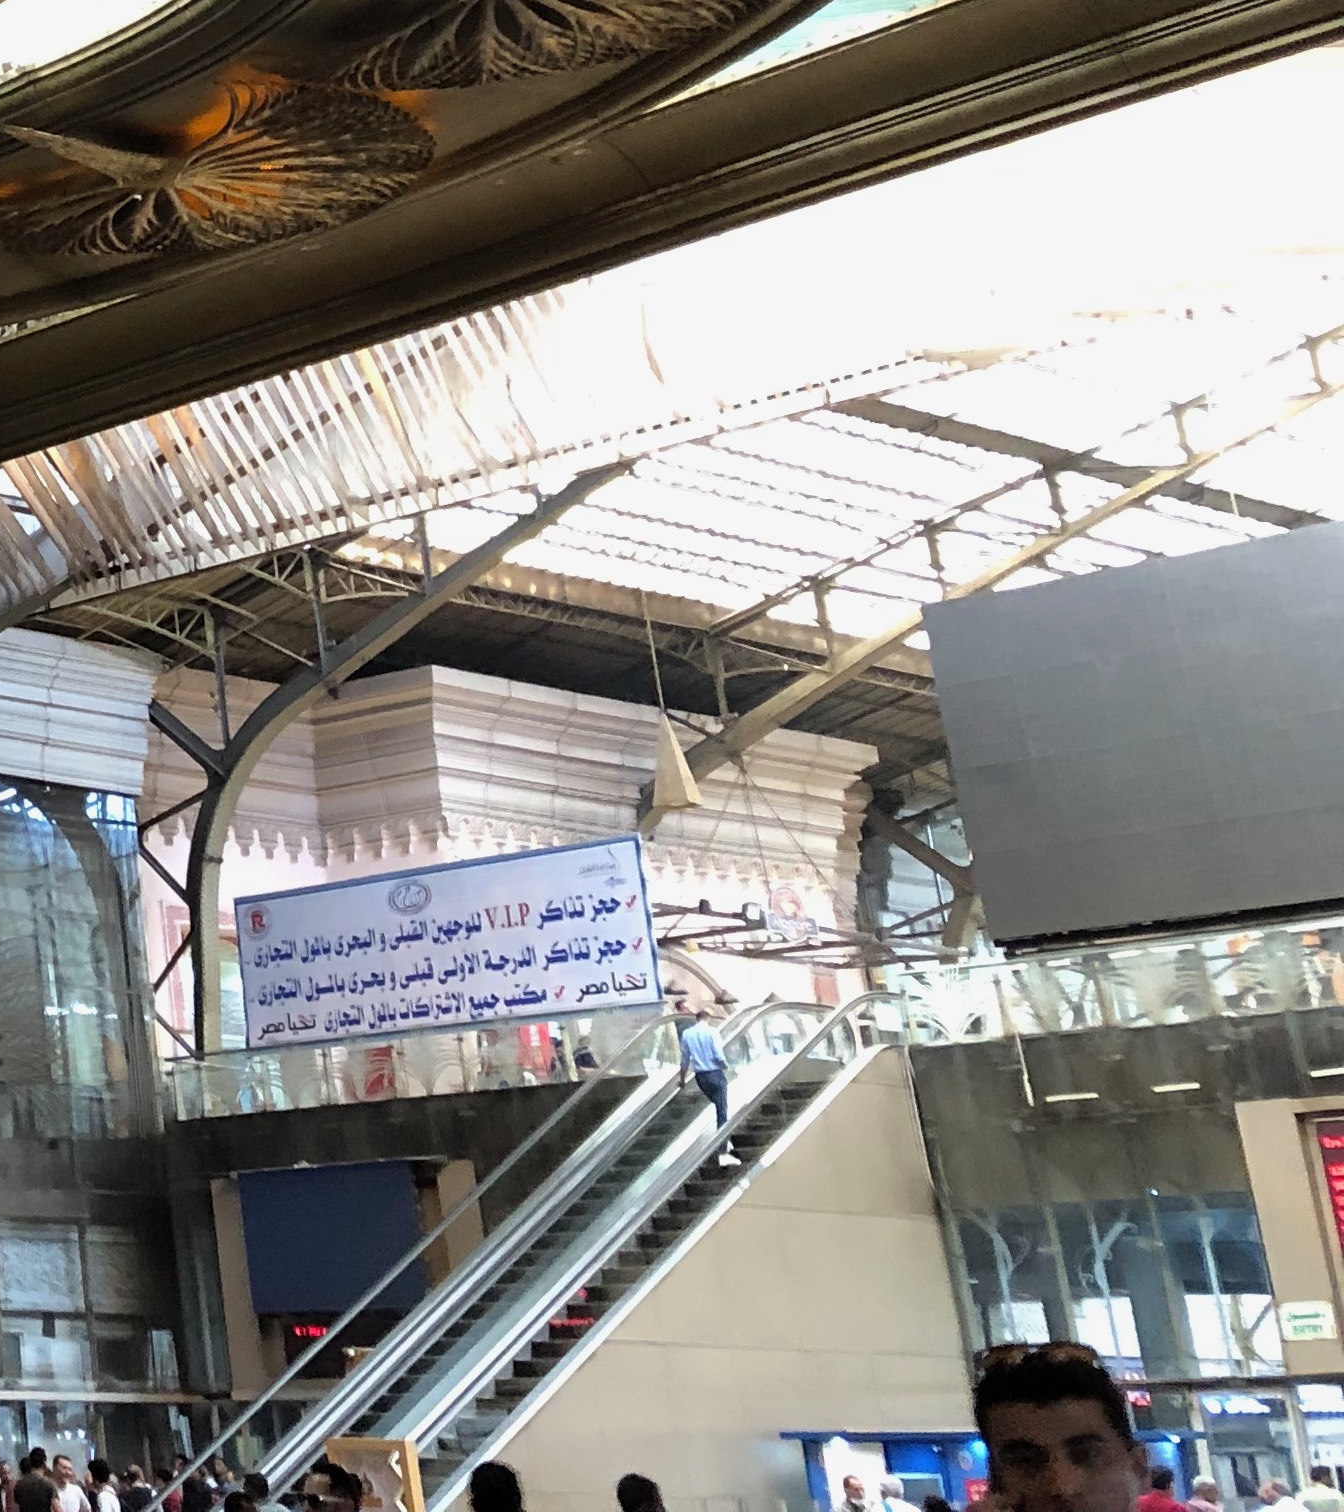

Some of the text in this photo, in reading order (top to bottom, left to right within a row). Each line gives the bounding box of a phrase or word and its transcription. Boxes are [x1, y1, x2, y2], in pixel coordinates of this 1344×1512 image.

[253, 893, 621, 968] حجز تذاكر V.I.P للوجهين القبلى و البحرى بالمول التجارى
[483, 944, 538, 977] الدرجة
[542, 936, 591, 971] تذاكر
[595, 936, 627, 964] حجز
[348, 971, 386, 995] بحرى
[389, 970, 397, 991] و
[399, 956, 434, 989] قبلى
[575, 971, 647, 1002] تحيا مصر
[257, 977, 303, 1008] التجارى
[399, 991, 466, 1021] الاشتراكات
[468, 991, 500, 1019] جميع
[503, 983, 548, 1013] مكتب
[257, 1010, 316, 1041] تحيا مصر
[324, 1004, 366, 1033] التجارى
